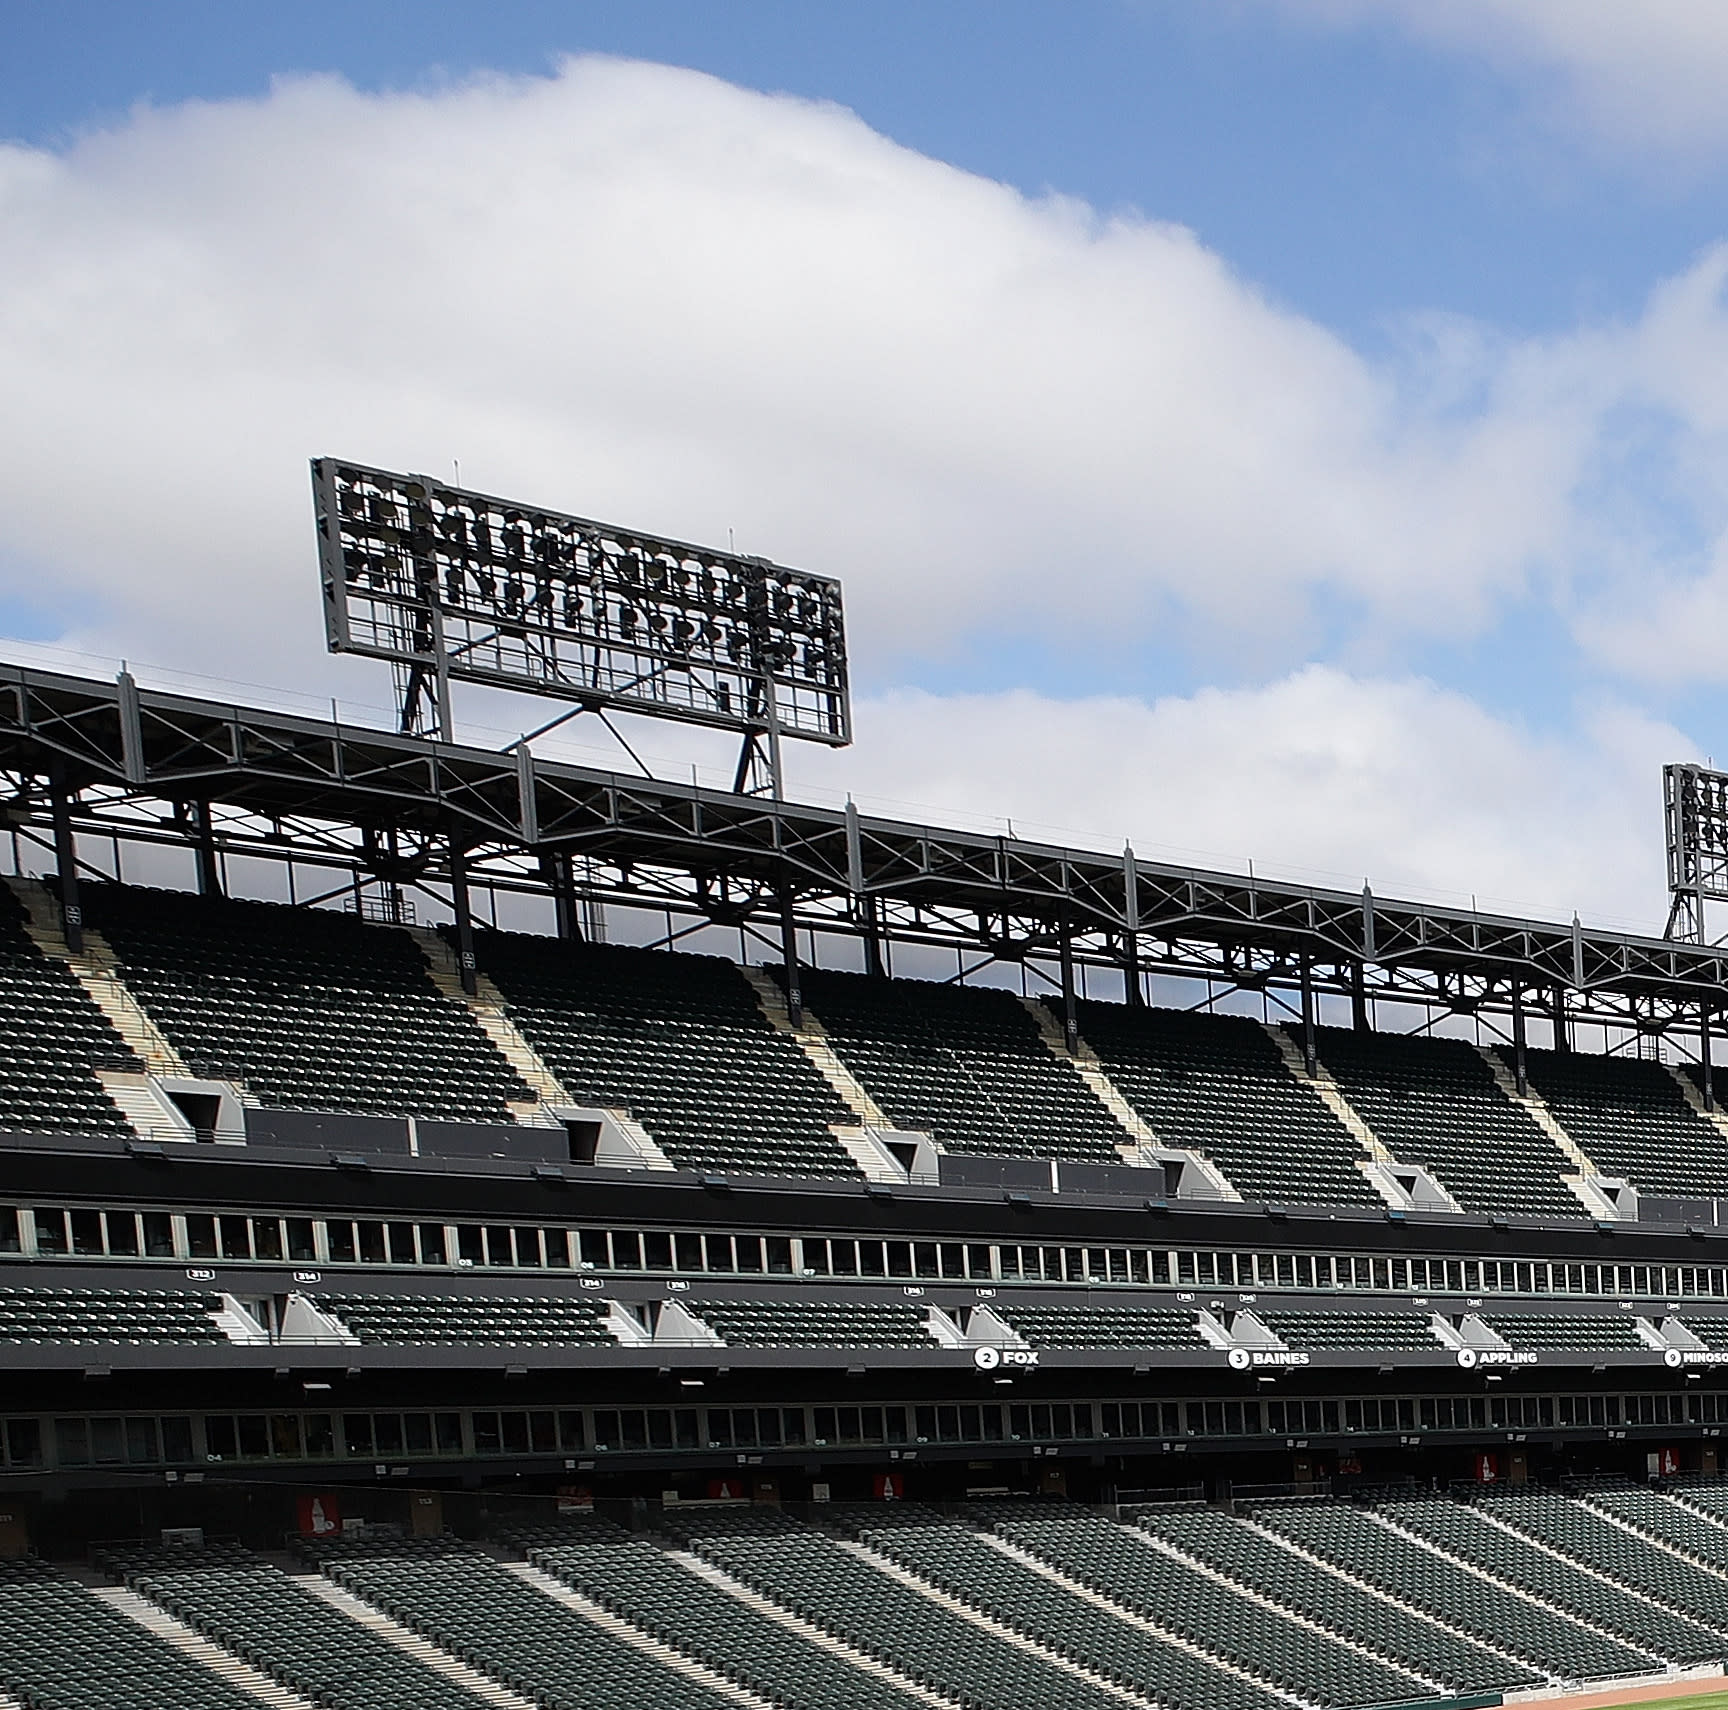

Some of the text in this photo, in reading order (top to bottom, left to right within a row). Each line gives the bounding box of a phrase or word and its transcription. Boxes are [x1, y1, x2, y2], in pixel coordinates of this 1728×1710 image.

[1003, 1351, 1040, 1364] FOX
[1252, 1352, 1310, 1365] BAINES
[1480, 1352, 1538, 1364] APPLING
